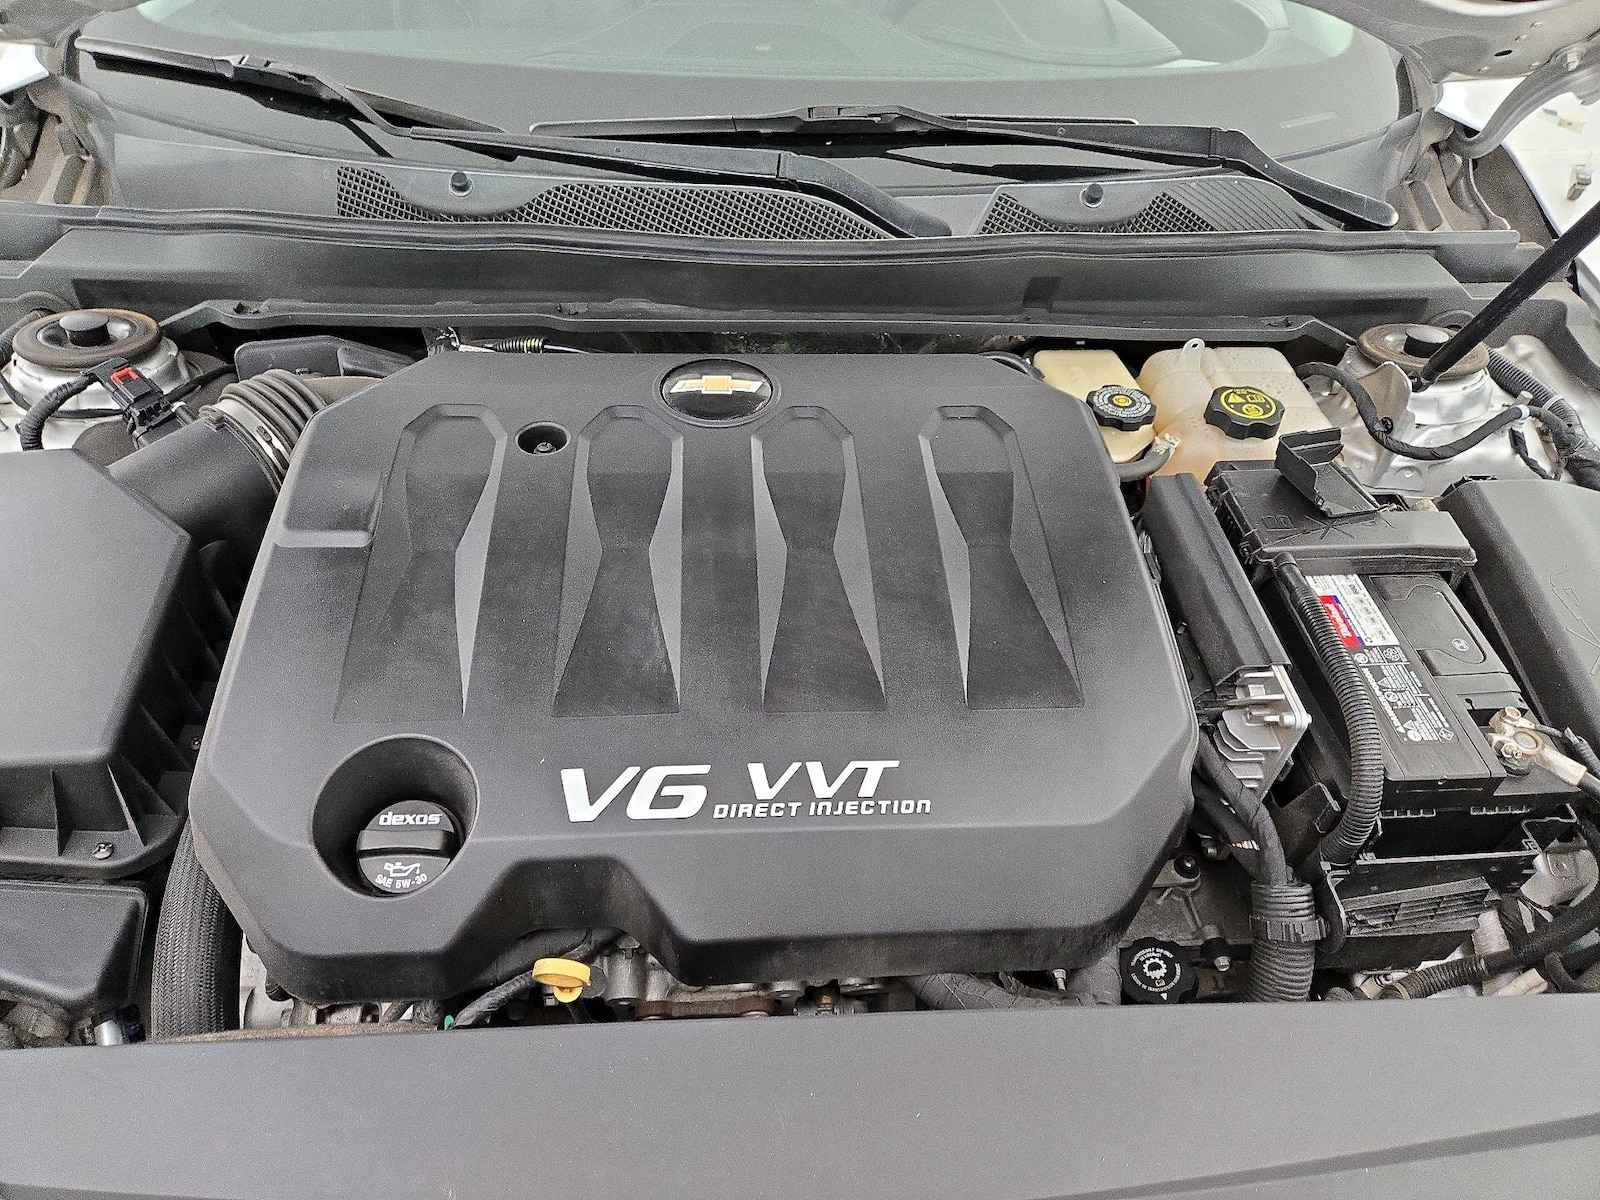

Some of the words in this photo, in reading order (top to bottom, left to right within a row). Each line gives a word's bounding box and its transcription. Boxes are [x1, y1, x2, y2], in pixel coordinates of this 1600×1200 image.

[560, 764, 712, 823] V6
[747, 760, 900, 800] VVT
[712, 801, 803, 819] DIRECT
[808, 799, 931, 816] INJECTION
[378, 811, 443, 826] dexos
[375, 873, 393, 888] SAE
[395, 872, 428, 889] 5W-30
